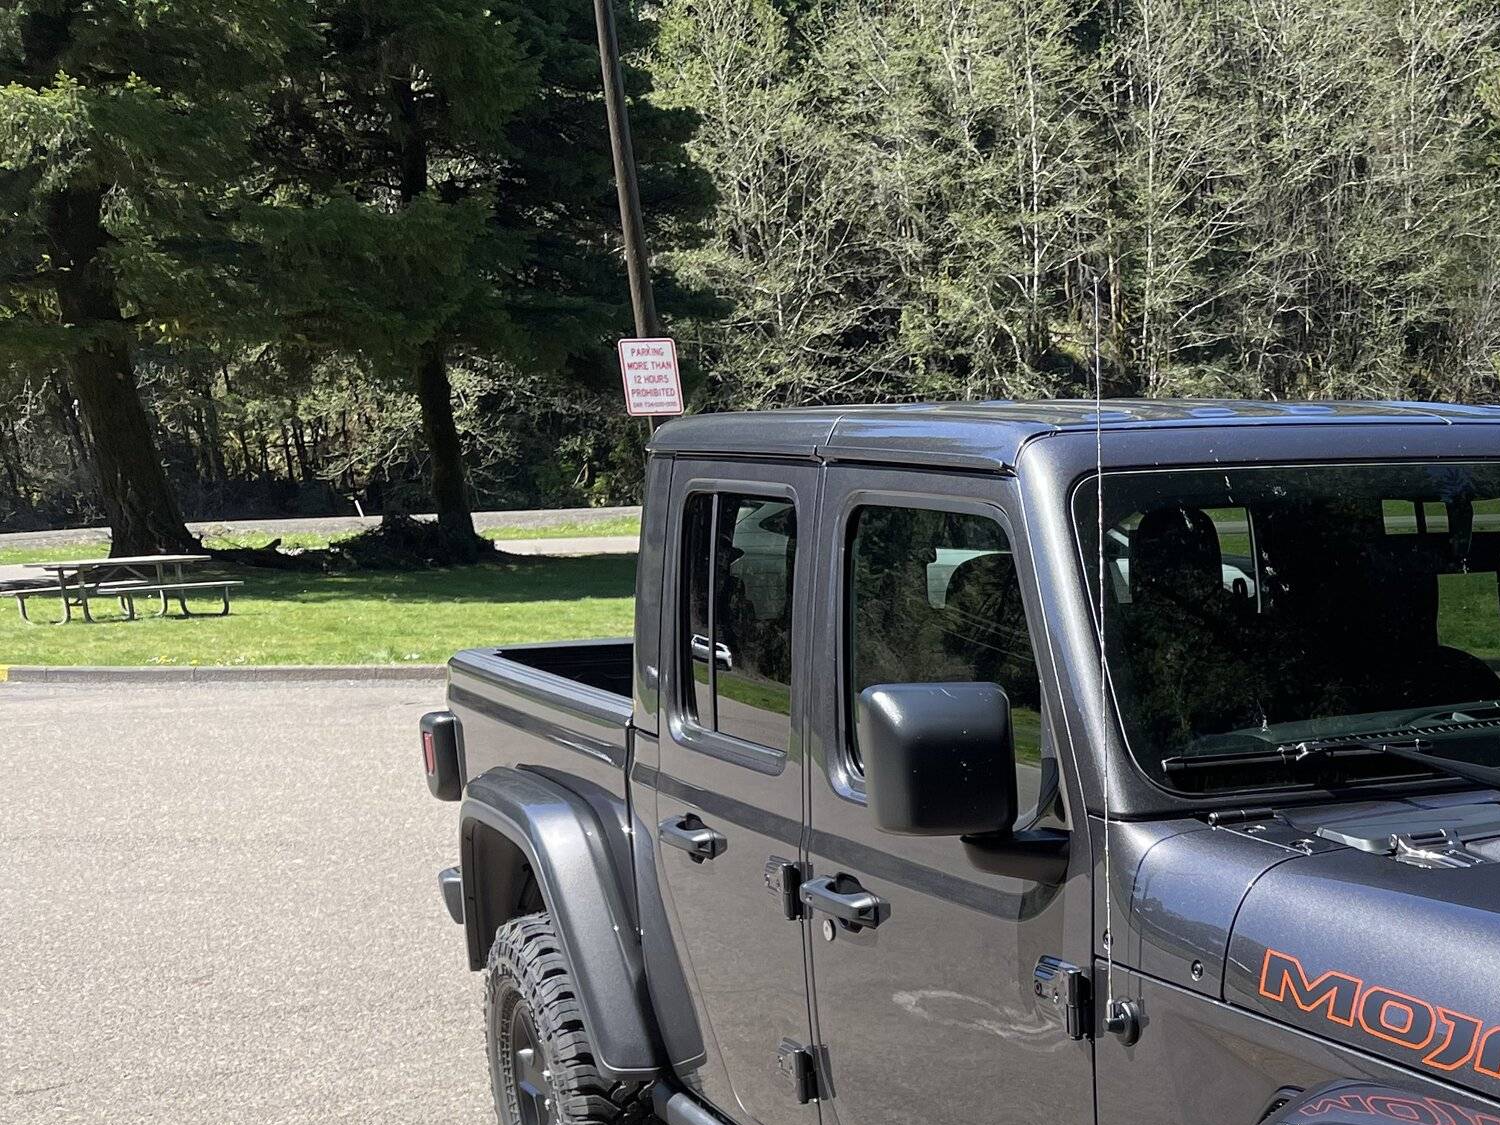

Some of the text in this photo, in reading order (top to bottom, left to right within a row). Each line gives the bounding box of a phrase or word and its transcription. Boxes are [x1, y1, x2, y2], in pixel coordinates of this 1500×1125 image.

[631, 347, 664, 356] PARKING
[627, 361, 672, 370] MORE THAN
[634, 374, 669, 384] 12 HOURS
[631, 388, 675, 397] PROHIBITED
